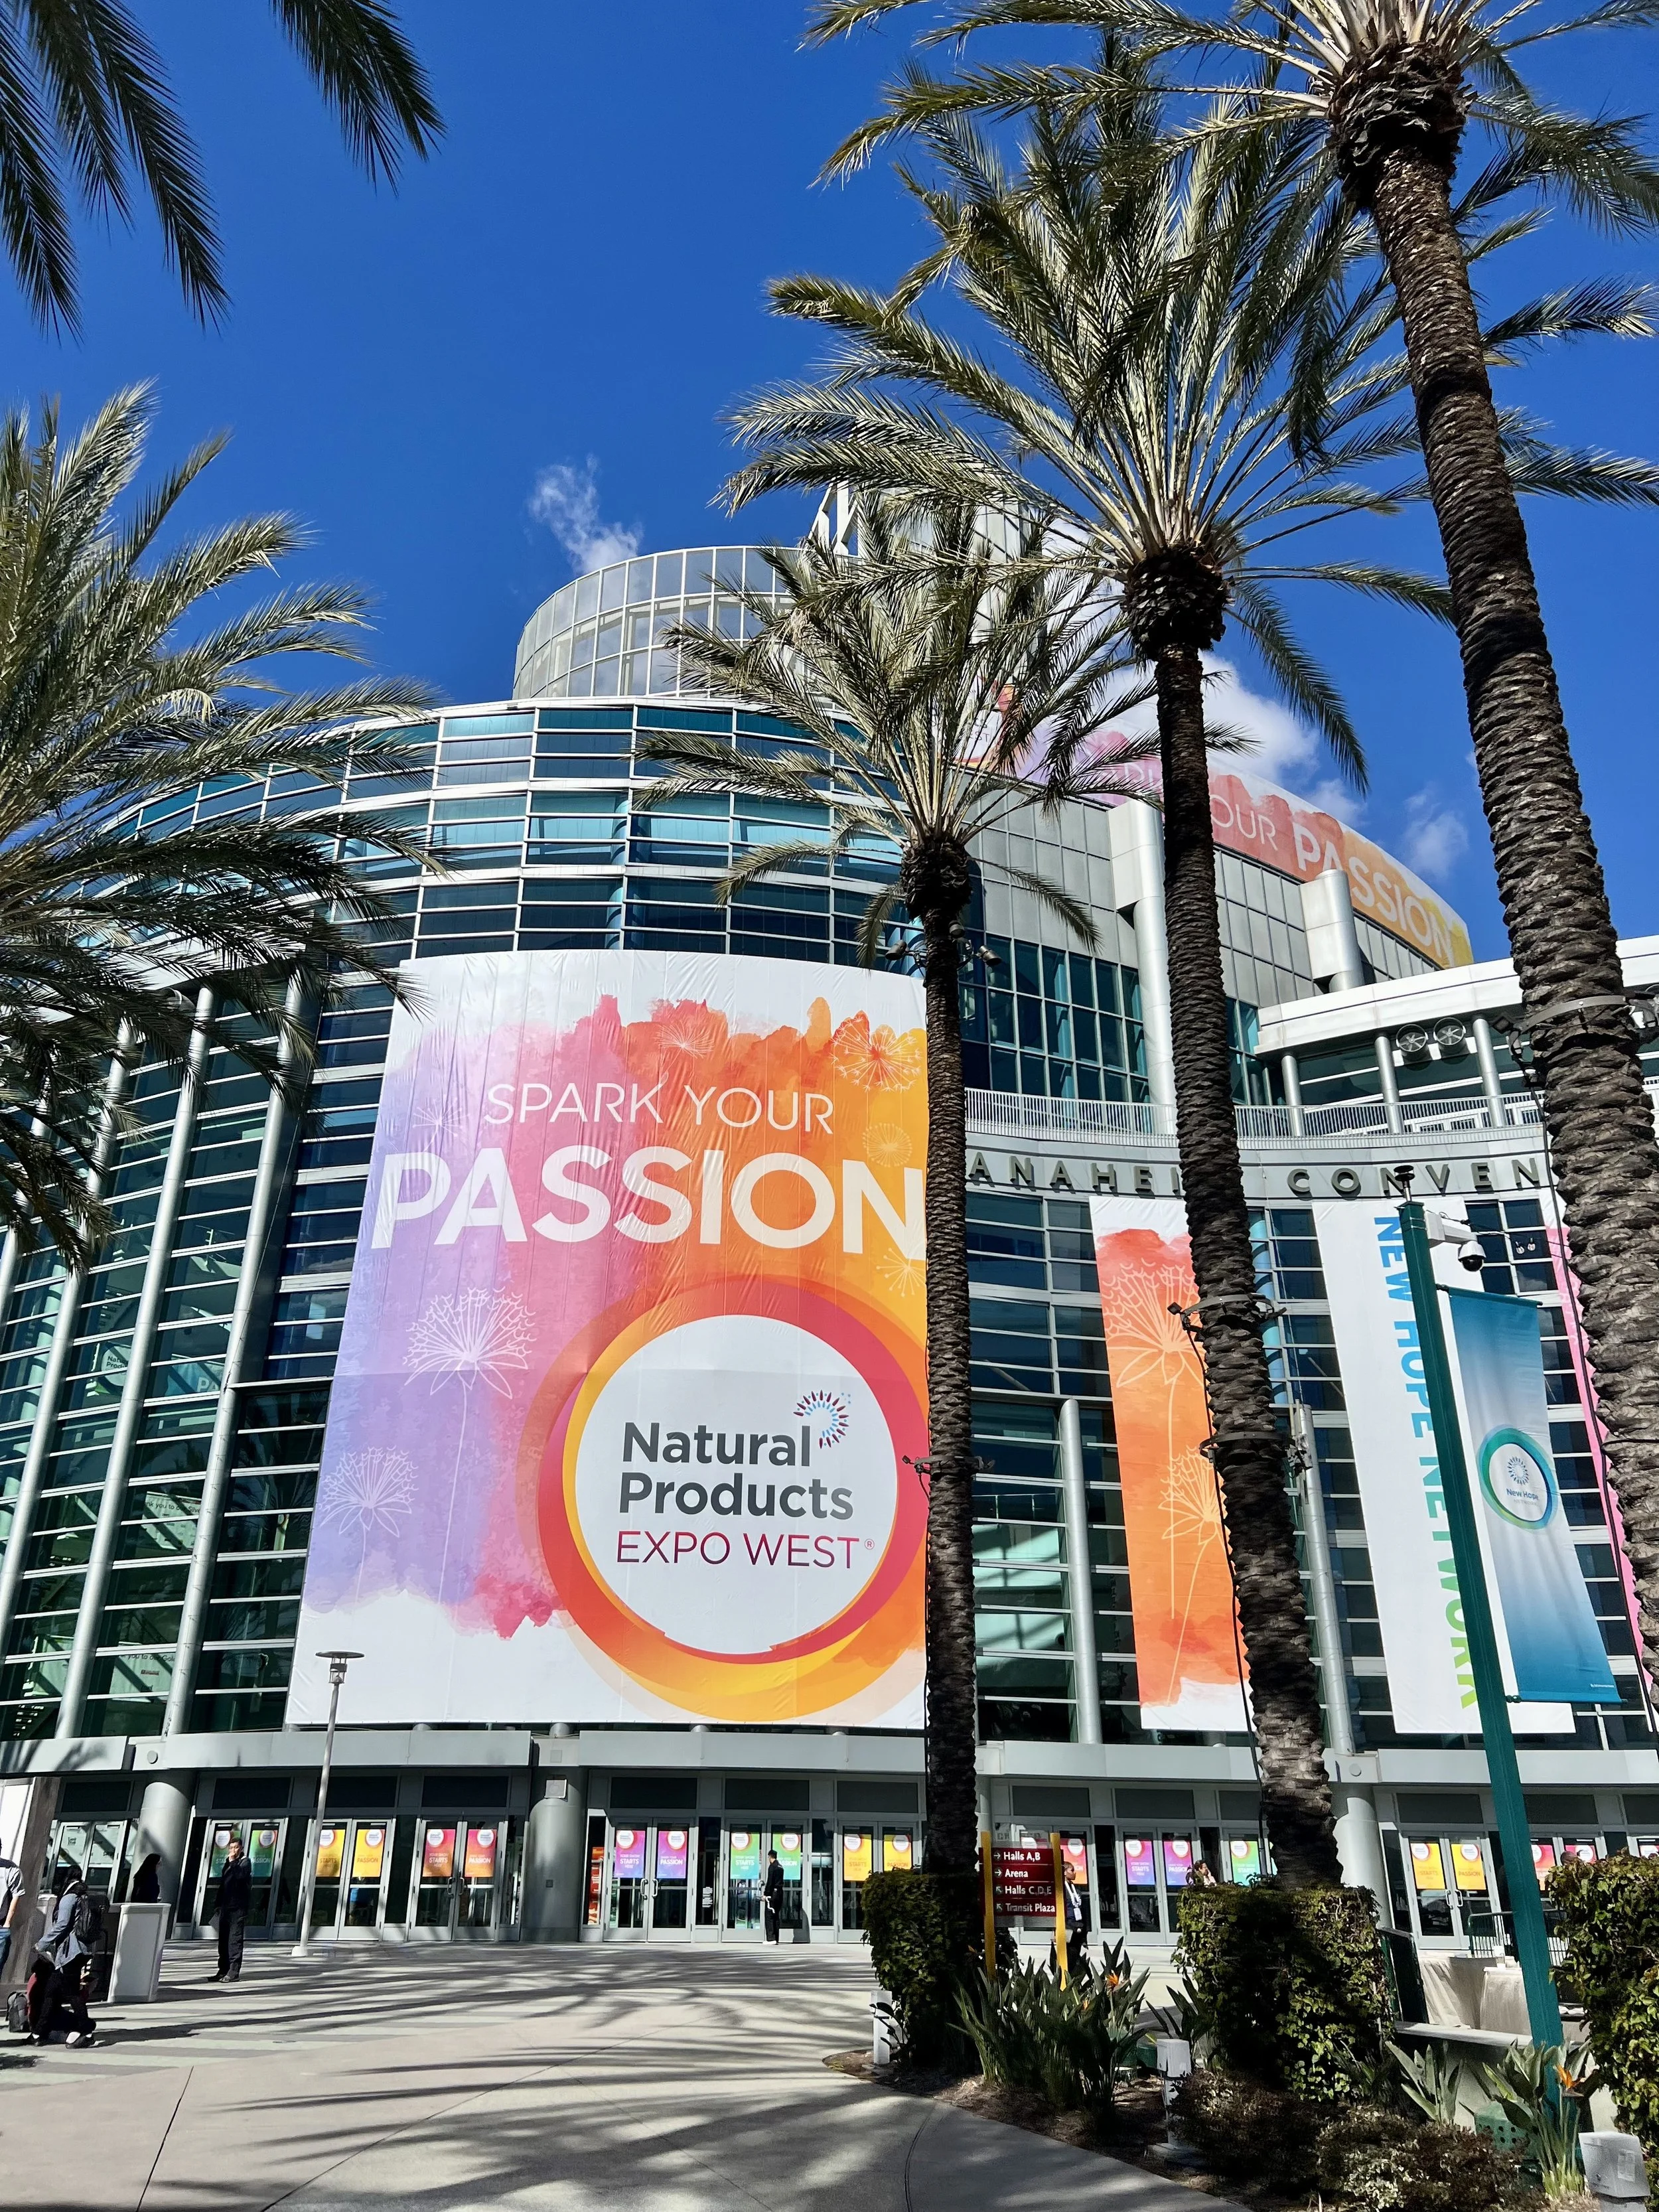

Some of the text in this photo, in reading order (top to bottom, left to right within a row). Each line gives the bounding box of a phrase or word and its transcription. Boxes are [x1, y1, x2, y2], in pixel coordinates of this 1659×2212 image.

[1210, 794, 1454, 967] OUR PASSION
[484, 1082, 834, 1135] SPARK YOUR
[968, 1151, 1539, 1197] ANAHEI CONVEN
[371, 1145, 927, 1261] PASSION
[1374, 1216, 1413, 1301] NEW
[622, 1422, 811, 1467] Natural
[618, 1472, 854, 1520] Products
[1506, 1488, 1539, 1500] New Hope
[616, 1530, 731, 1565] EXPO
[1003, 1851, 1041, 1862] Halls A,B
[1005, 1868, 1029, 1878] Arena
[1005, 1885, 1026, 1895] Halls
[1005, 1903, 1055, 1913] Transit Plaza
